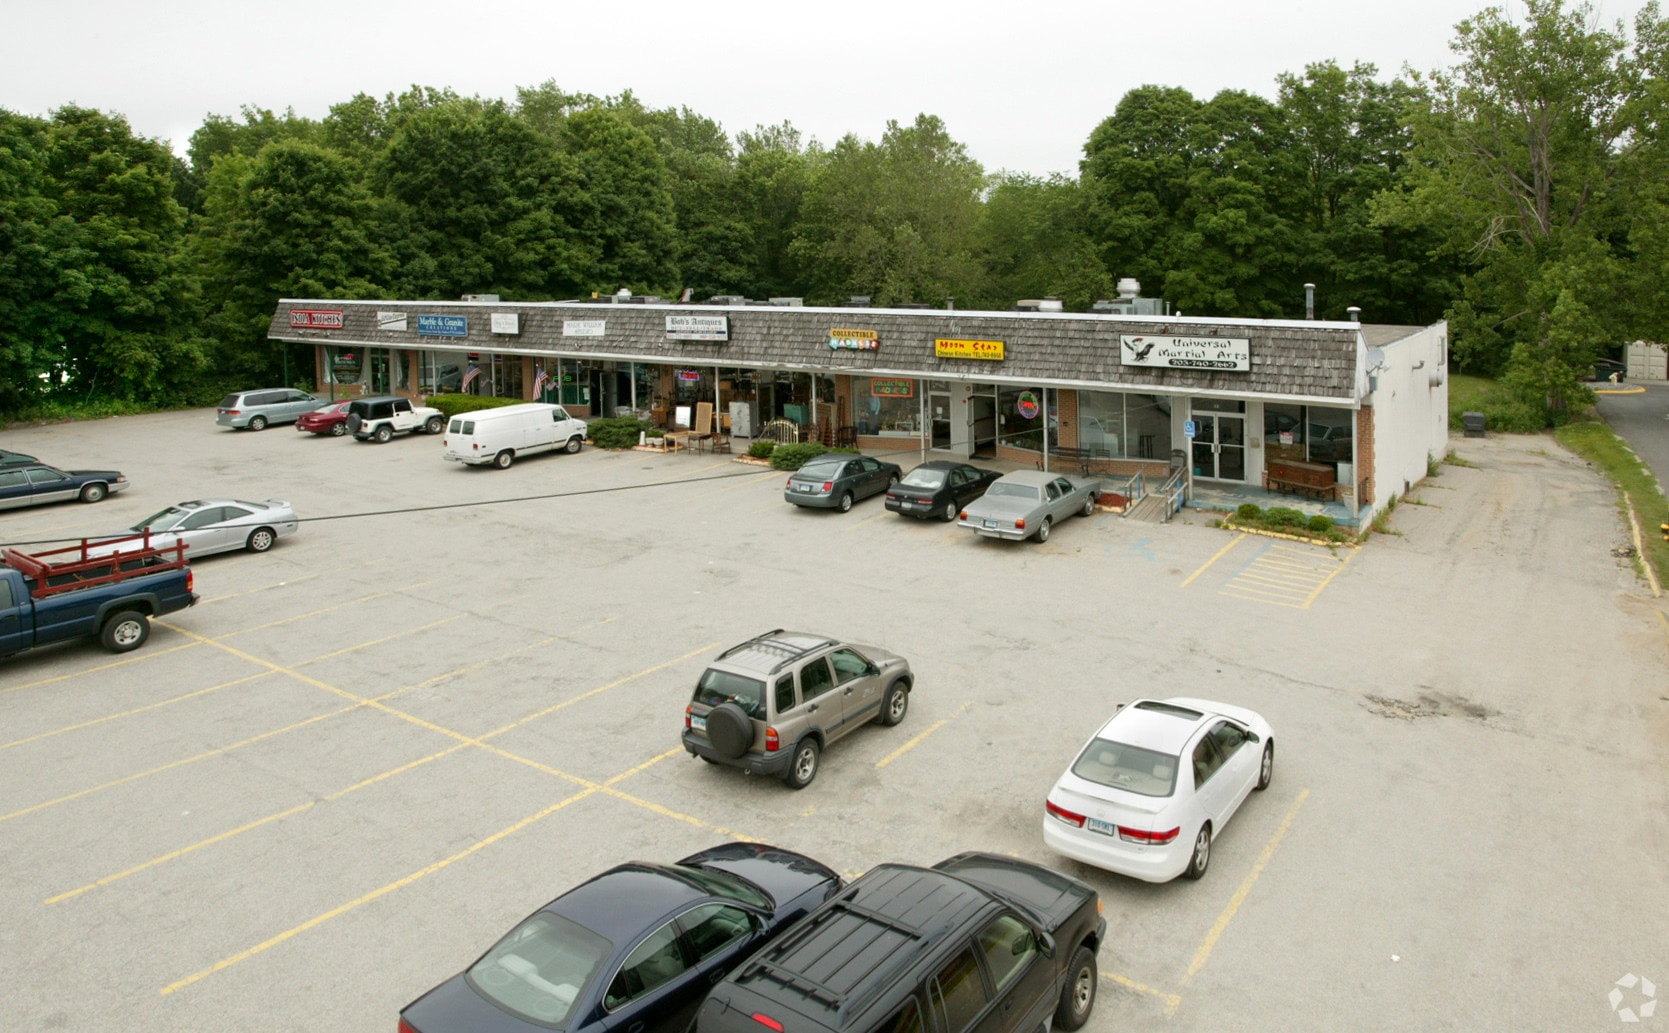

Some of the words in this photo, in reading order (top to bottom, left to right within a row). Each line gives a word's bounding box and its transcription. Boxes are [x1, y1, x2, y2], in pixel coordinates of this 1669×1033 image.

[671, 317, 690, 326] Bob's
[691, 317, 722, 327] Antiques
[832, 330, 874, 338] COLLECTIBLE
[940, 341, 965, 349] Moon
[972, 342, 998, 351] Star
[1173, 339, 1231, 348] Universal
[1158, 348, 1206, 358] Martial
[1217, 351, 1247, 360] Arts
